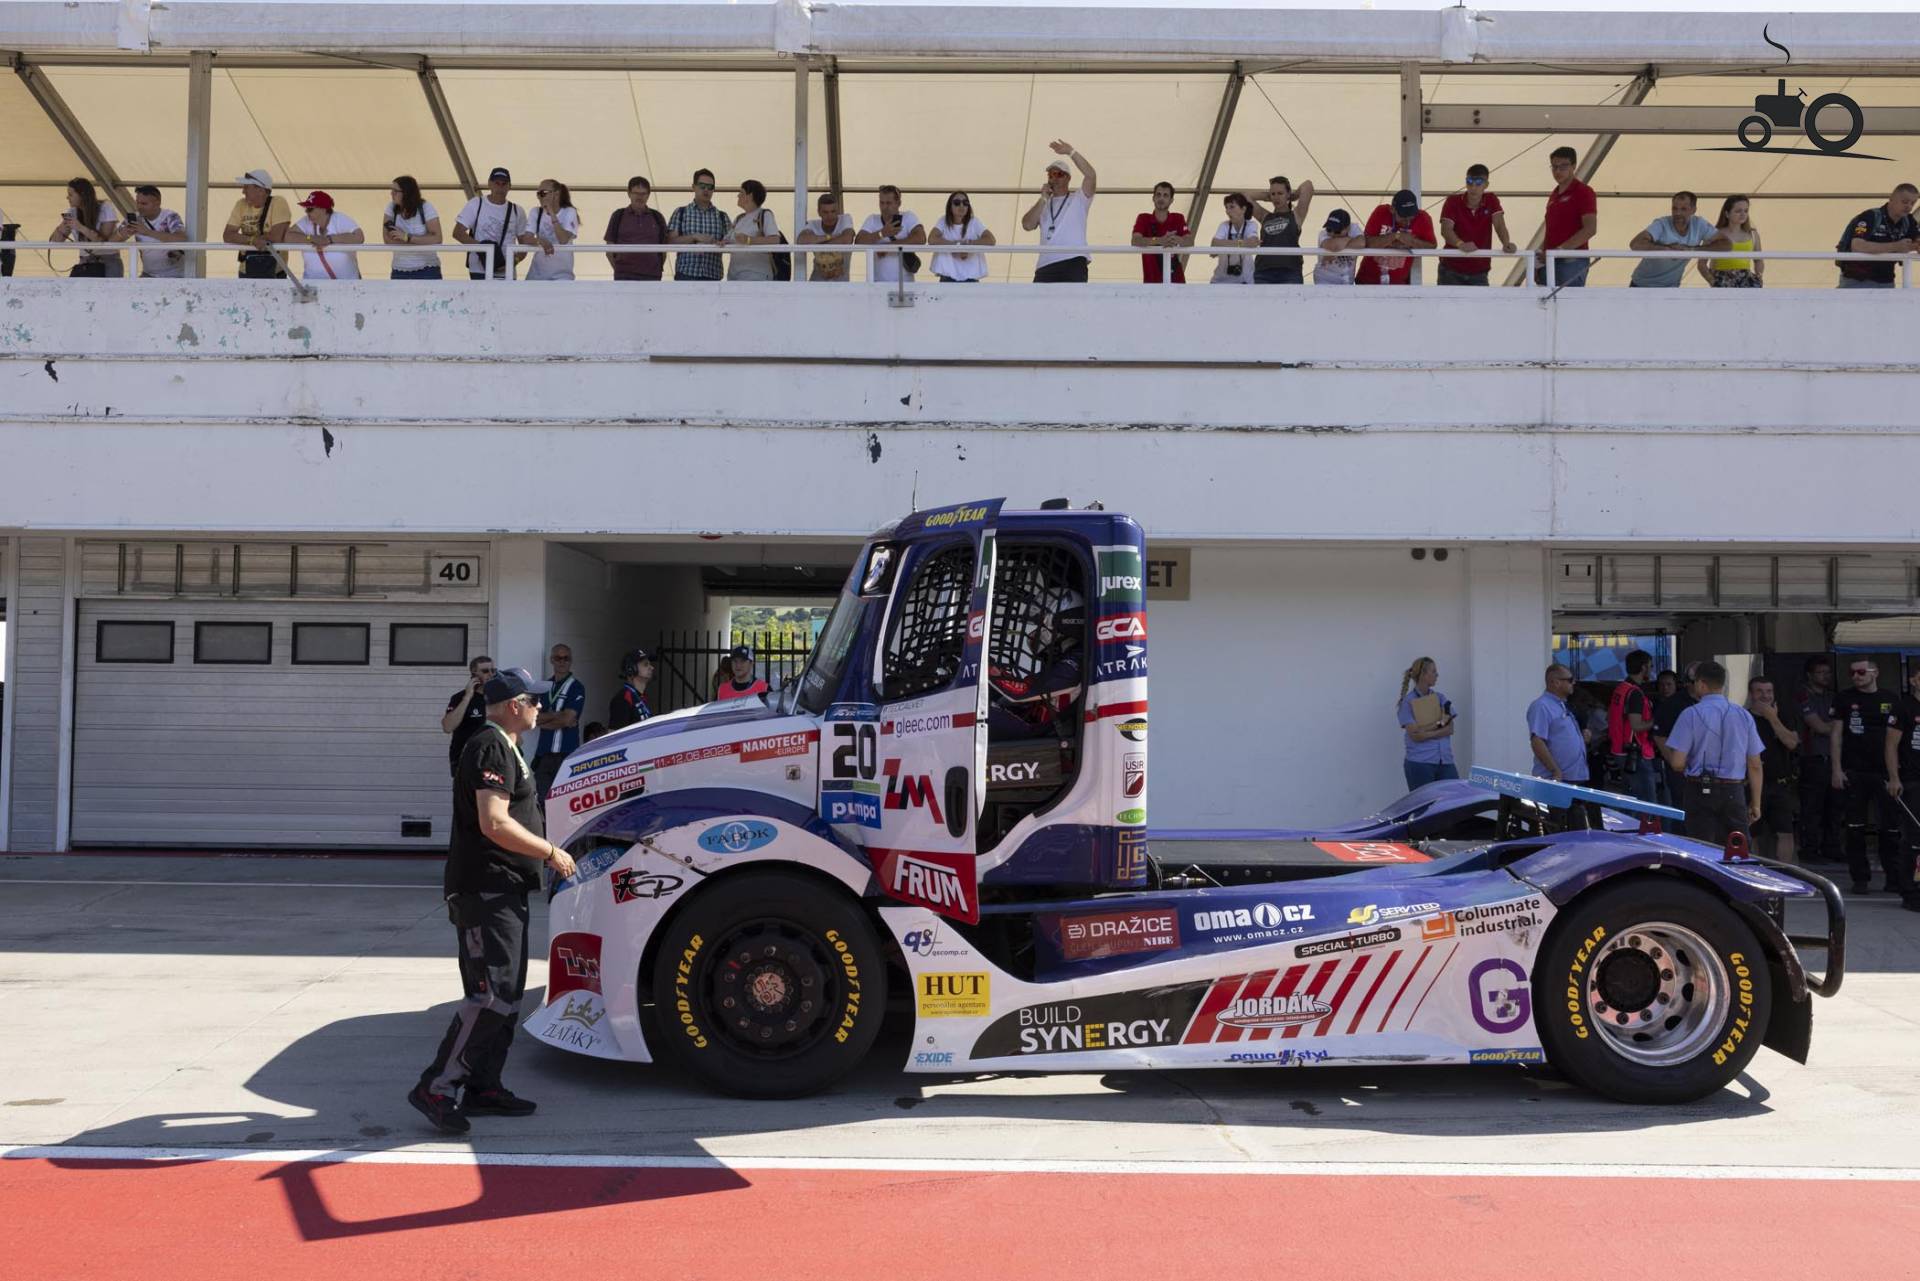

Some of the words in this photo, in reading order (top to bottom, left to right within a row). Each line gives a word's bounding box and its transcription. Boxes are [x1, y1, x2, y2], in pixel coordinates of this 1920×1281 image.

[925, 506, 988, 528] GOODYEAR
[439, 562, 471, 581] 40
[1101, 571, 1142, 597] jurex
[1096, 617, 1145, 641] GCA
[896, 714, 950, 738] gleec.com
[742, 733, 806, 753] NANOTECH
[832, 723, 877, 780] 20
[572, 753, 623, 774] RAVENOL
[551, 764, 639, 798] HUNGARORING
[621, 777, 643, 792] fren
[569, 784, 619, 813] GOLD
[832, 801, 877, 821] pumpa
[893, 854, 969, 913] FRUM
[1193, 908, 1252, 931] oma
[1455, 898, 1541, 923] Columnate
[1090, 915, 1173, 938] DRAŽICE
[1213, 926, 1305, 944] www.omacz.cz
[1143, 935, 1174, 947] NIBE
[1300, 940, 1348, 957] SPECIAL
[1355, 930, 1396, 946] TURBO
[674, 933, 708, 1049] GOODYEAR
[825, 929, 861, 1043] GOODYEAR
[924, 975, 985, 996] HUT
[1567, 926, 1607, 1039] GOODYEAR
[1019, 1005, 1082, 1026] BUILD
[1234, 991, 1317, 1018] JORDÁK
[1711, 952, 1754, 1066] GOODYEAR
[1020, 1018, 1171, 1053] SYNERGY
[914, 1051, 954, 1063] EXIDE
[1472, 1049, 1540, 1064] GOODYEAR
